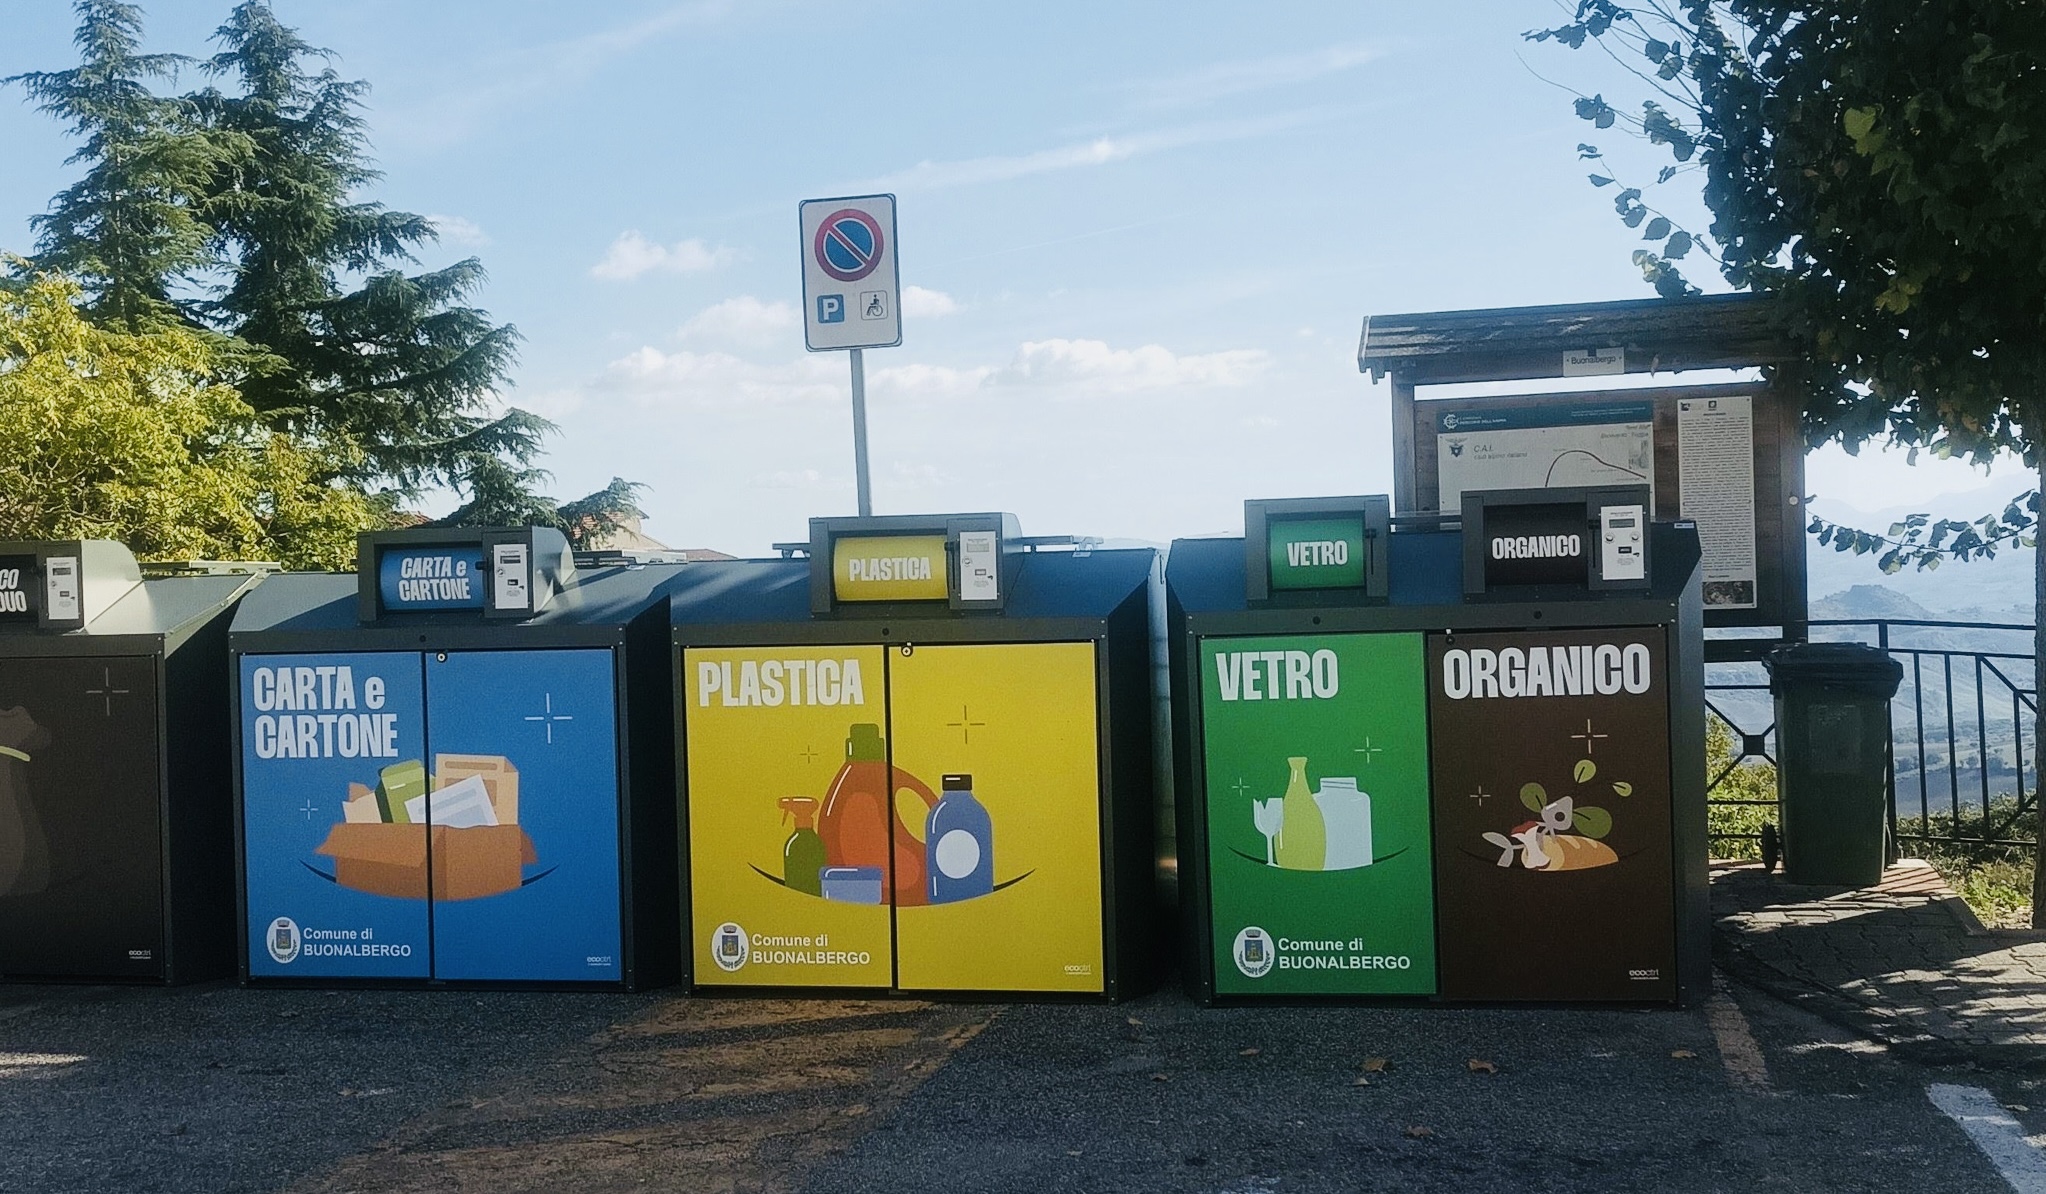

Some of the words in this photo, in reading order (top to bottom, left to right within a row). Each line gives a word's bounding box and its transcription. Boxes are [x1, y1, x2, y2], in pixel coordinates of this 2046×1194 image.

[823, 298, 839, 321] P
[1286, 540, 1348, 567] VETRO
[1492, 534, 1581, 560] ORGANICO
[401, 556, 452, 578] CARTA
[456, 560, 467, 577] e
[849, 557, 932, 582] PLASTICA
[399, 578, 471, 601] CARTONE
[698, 659, 865, 707] PLASTICA
[1215, 649, 1339, 701] VETRO
[1443, 643, 1651, 700] ORGANICO
[253, 666, 357, 711] CARTA
[364, 676, 386, 710] e
[254, 713, 399, 759] CARTONE
[303, 927, 358, 940] Comune
[360, 928, 373, 940] di
[751, 933, 812, 947] Comune
[815, 934, 829, 947] di
[1278, 937, 1344, 951] Comune
[1348, 938, 1363, 951] di
[303, 944, 412, 957] BUONALBERGO
[752, 951, 871, 965] BUONALBERGO
[1278, 956, 1411, 970] BUONALBERGO
